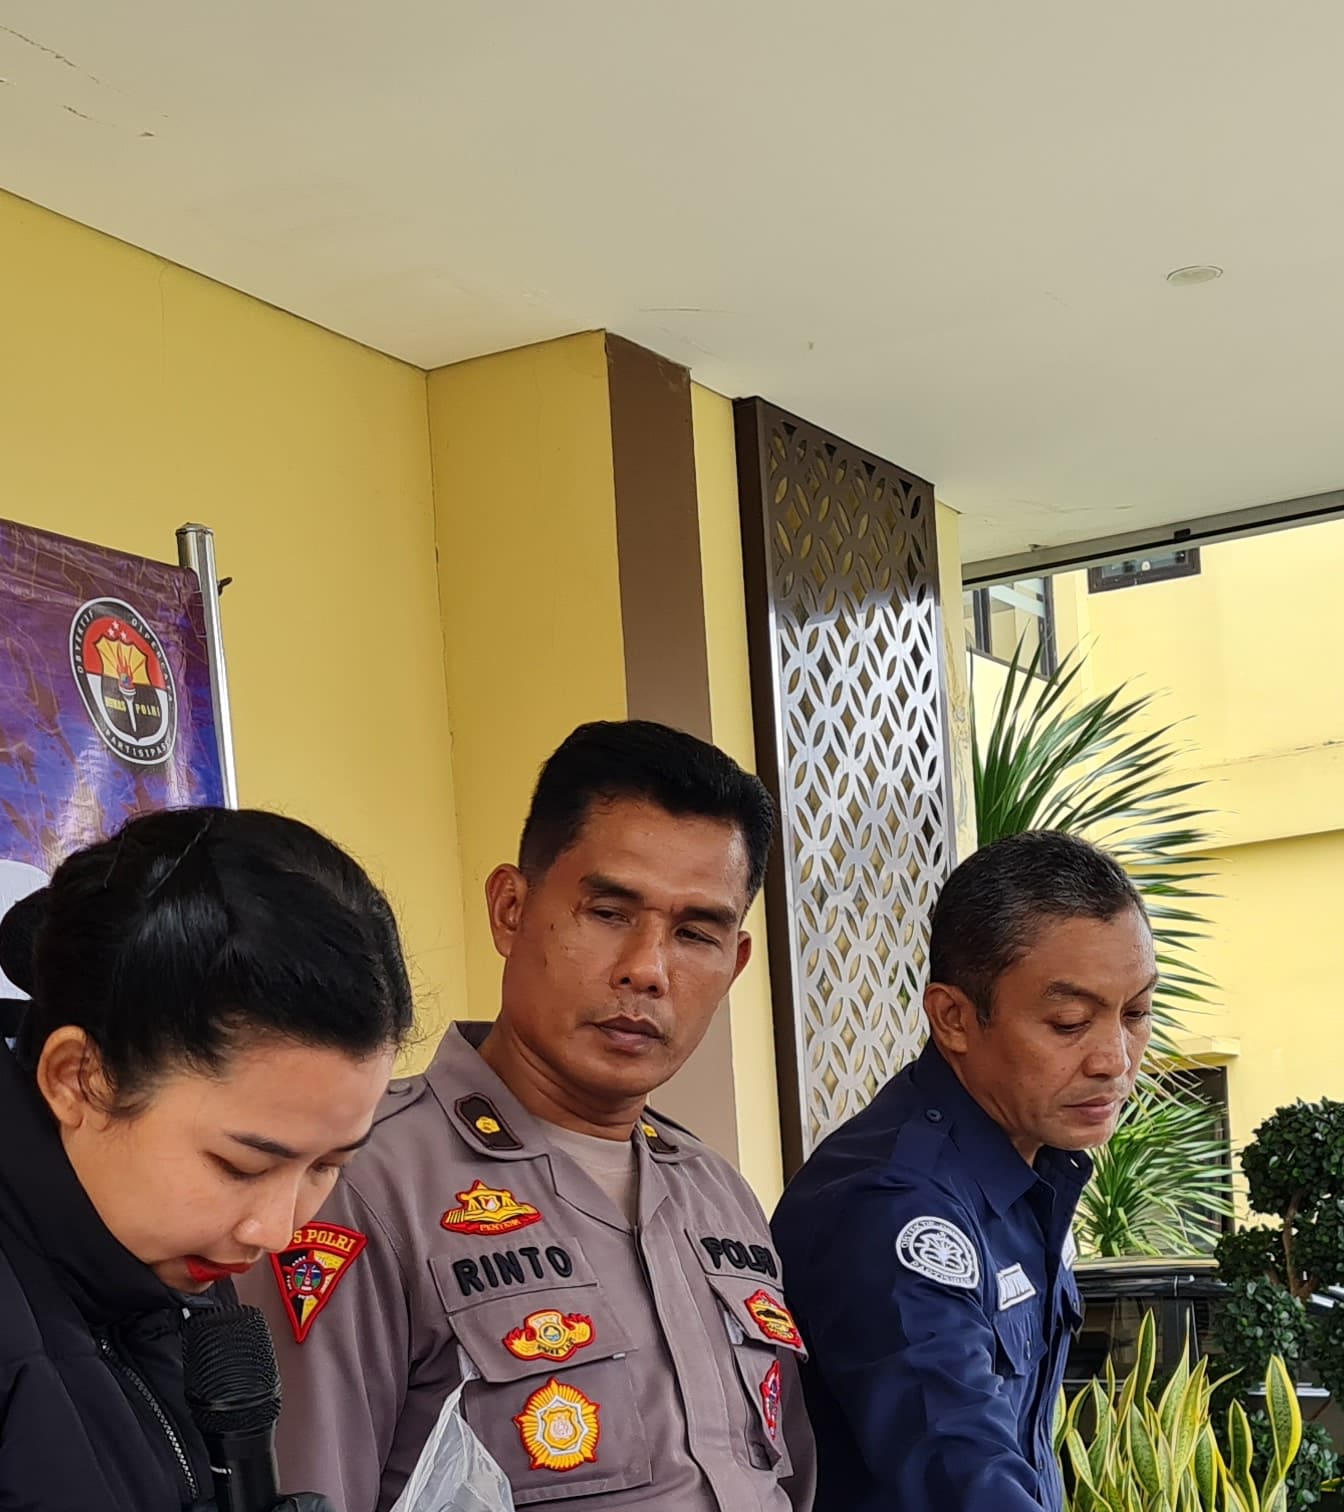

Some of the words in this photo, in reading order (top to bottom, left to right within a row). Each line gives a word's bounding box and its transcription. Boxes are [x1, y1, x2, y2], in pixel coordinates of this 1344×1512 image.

[303, 1229, 356, 1252] POLRI
[701, 1237, 778, 1280] POLRI
[452, 1245, 573, 1297] RINTO
